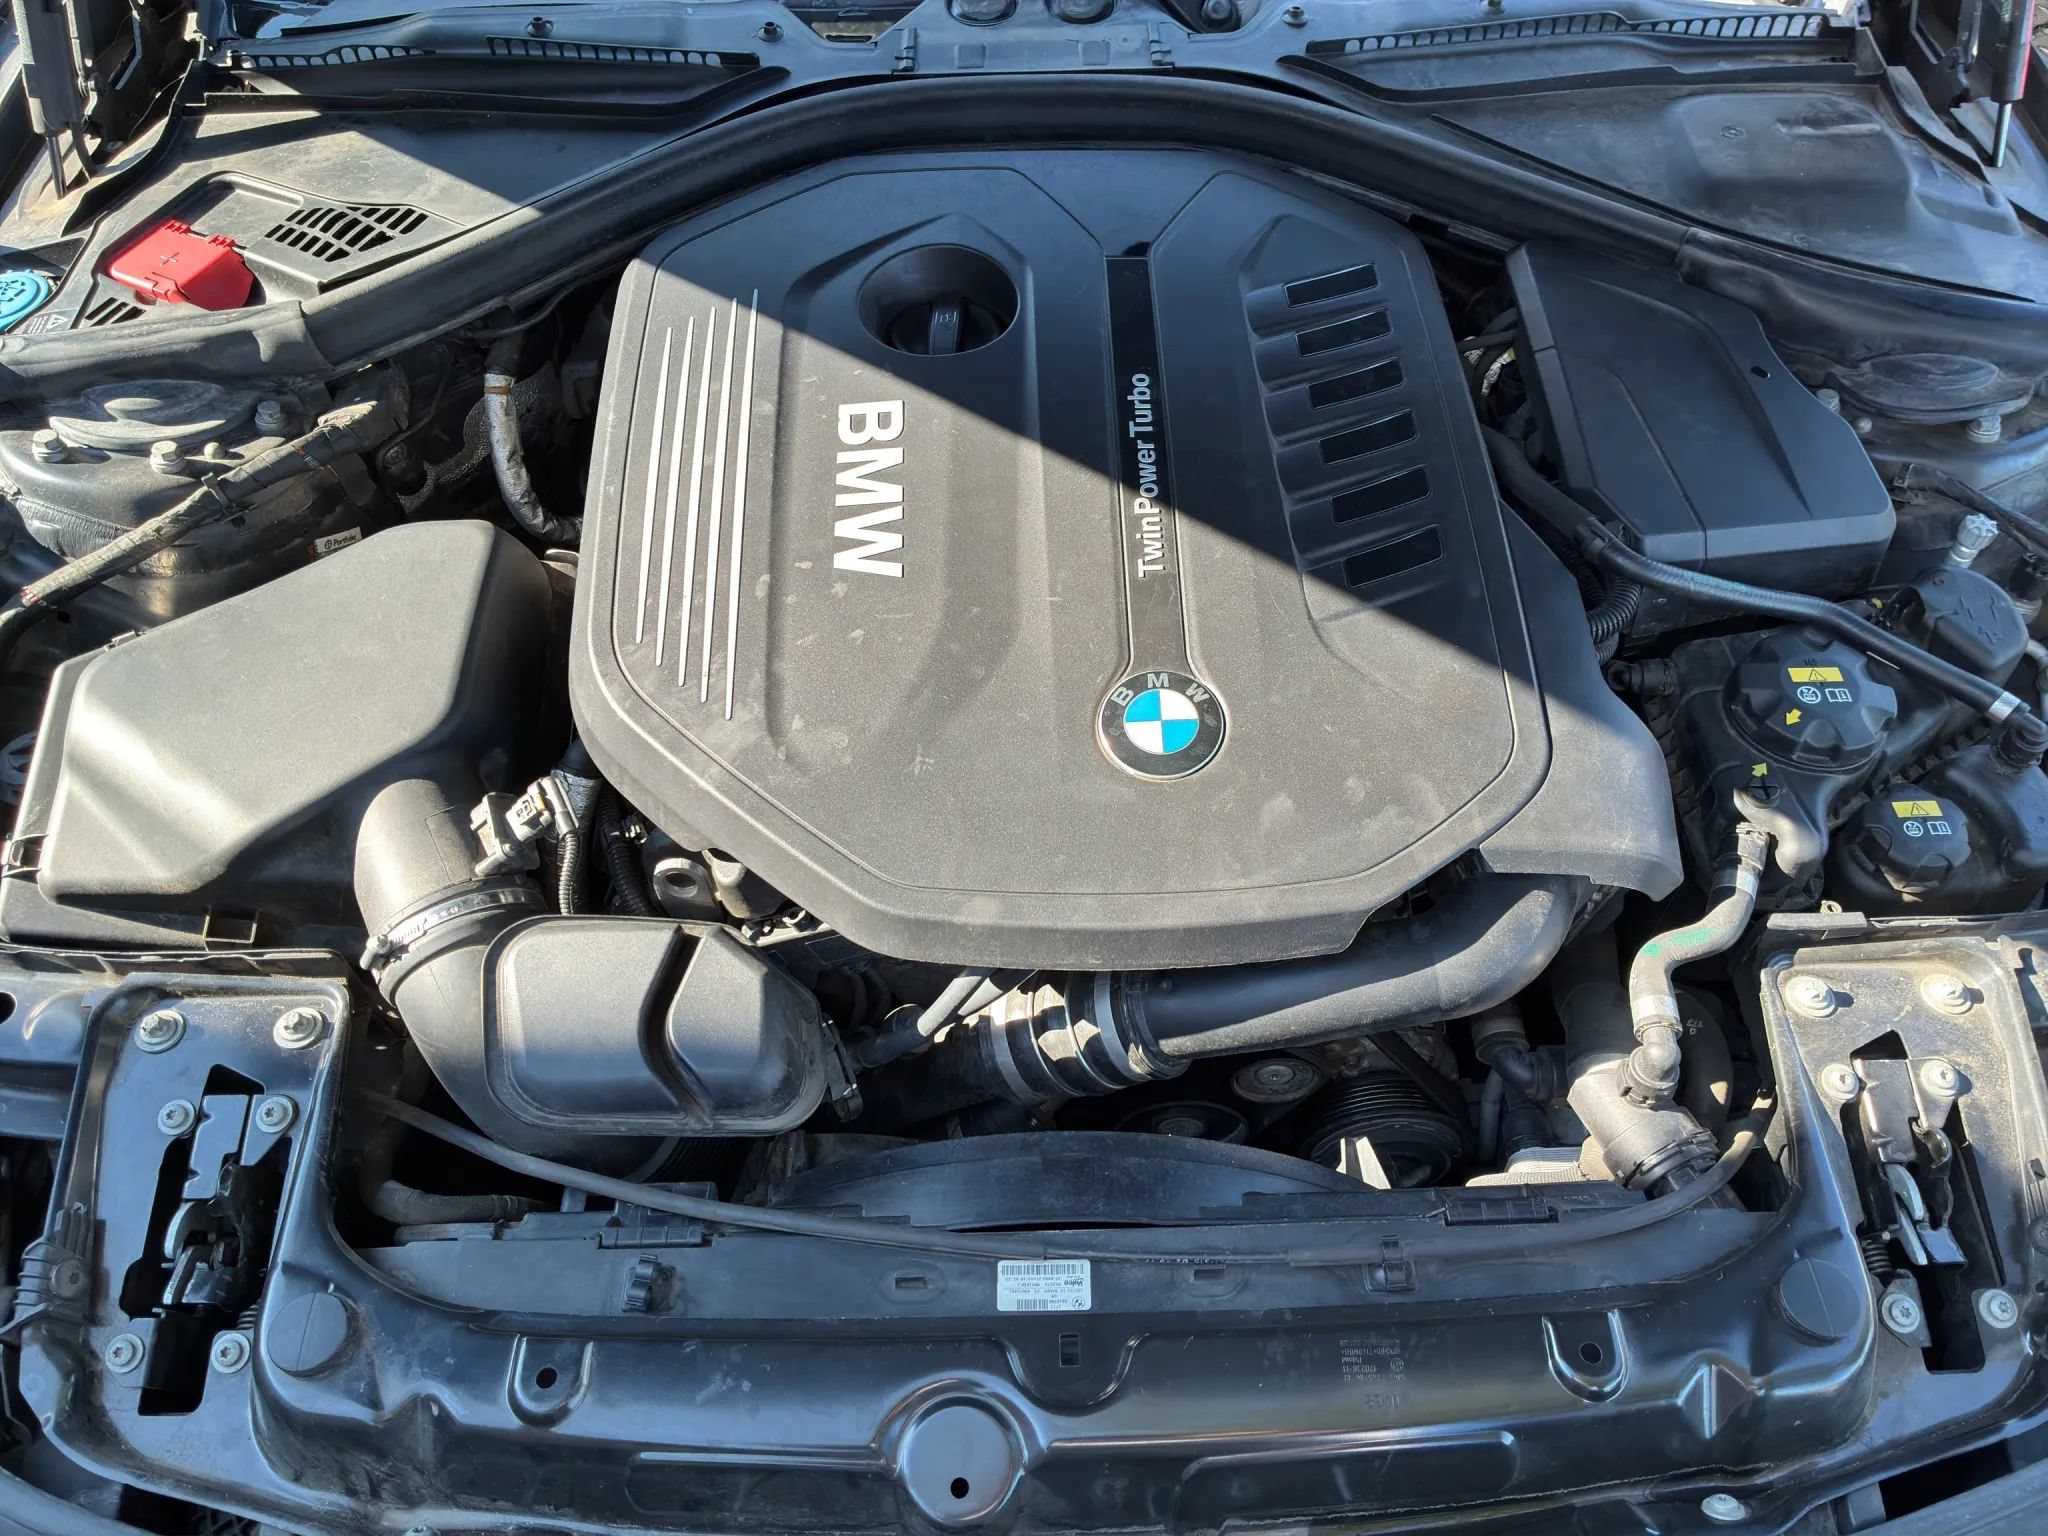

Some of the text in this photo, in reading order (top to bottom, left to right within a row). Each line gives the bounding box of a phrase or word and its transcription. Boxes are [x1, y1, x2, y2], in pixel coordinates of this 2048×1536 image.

[834, 400, 904, 578] BMW
[1127, 373, 1165, 578] TwinPower Turbo
[1111, 673, 1209, 707] BMW
